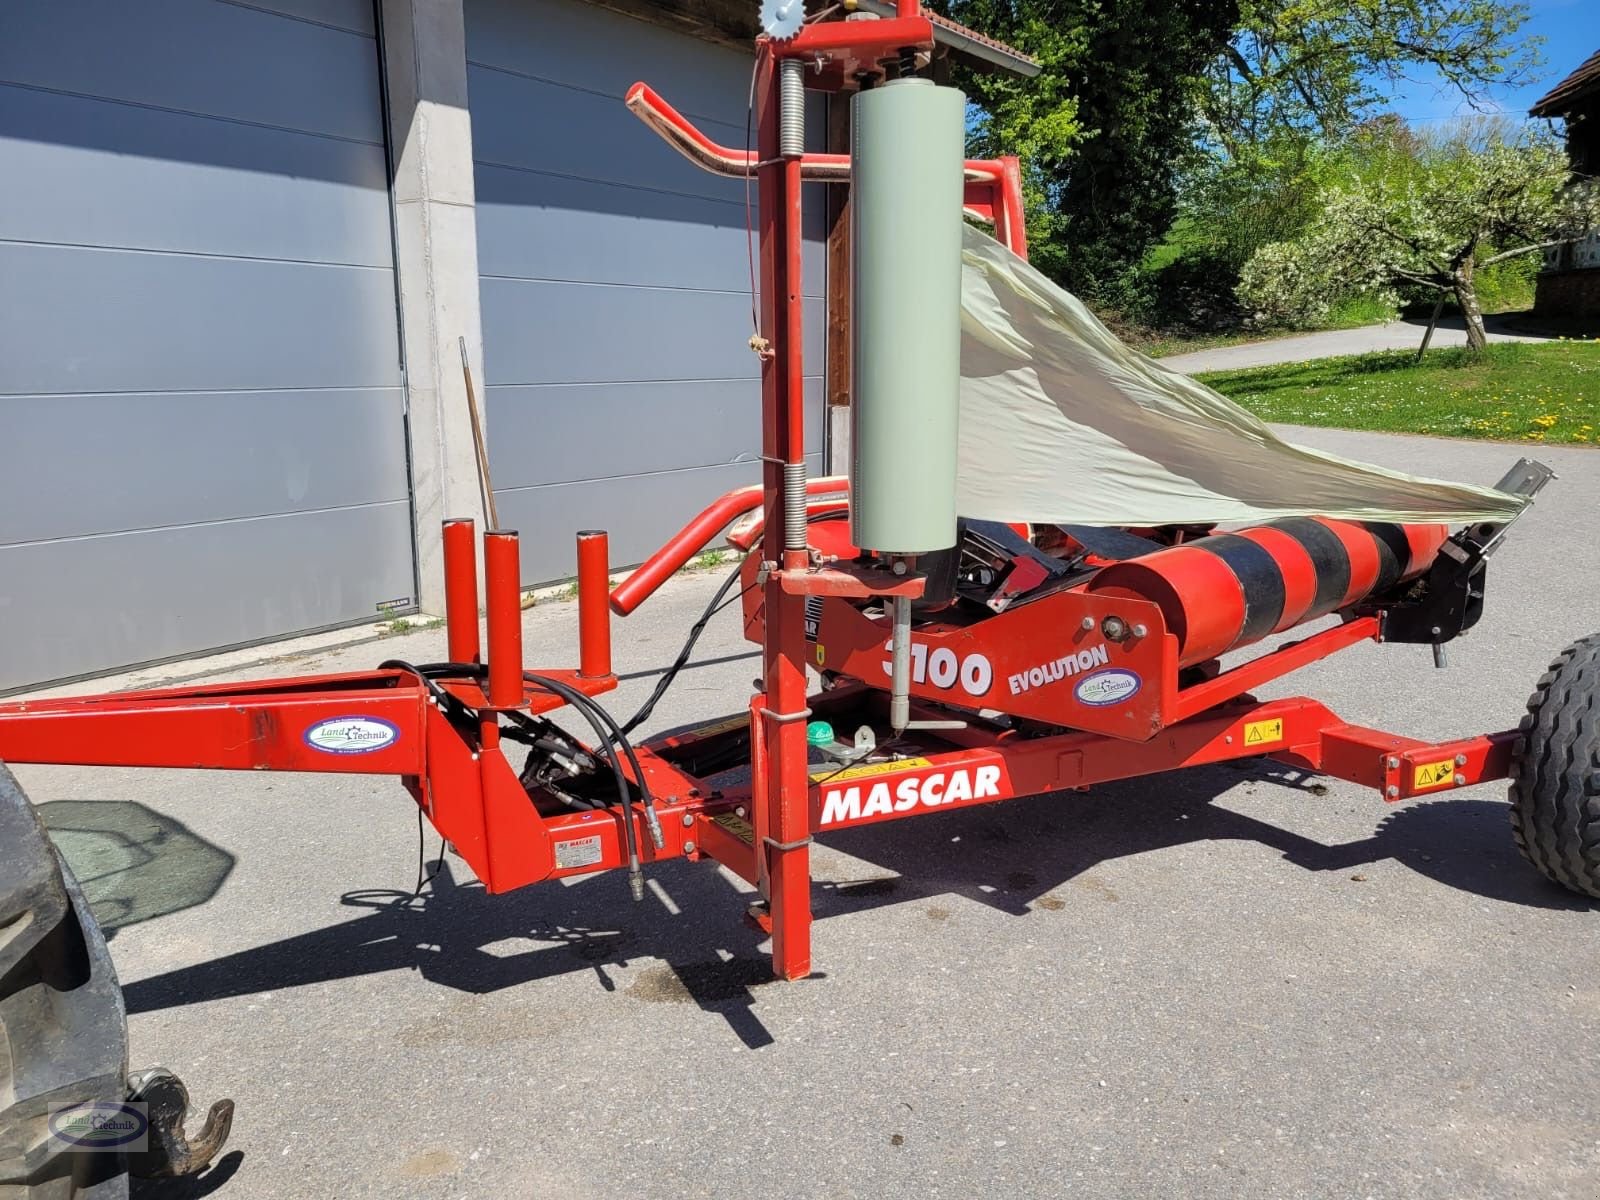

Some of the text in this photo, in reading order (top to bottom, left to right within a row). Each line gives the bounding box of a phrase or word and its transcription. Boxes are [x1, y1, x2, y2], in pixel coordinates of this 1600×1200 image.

[1007, 643, 1110, 696] EVOLUTION
[321, 727, 388, 741] Land Technik
[820, 765, 1001, 825] MASCAR
